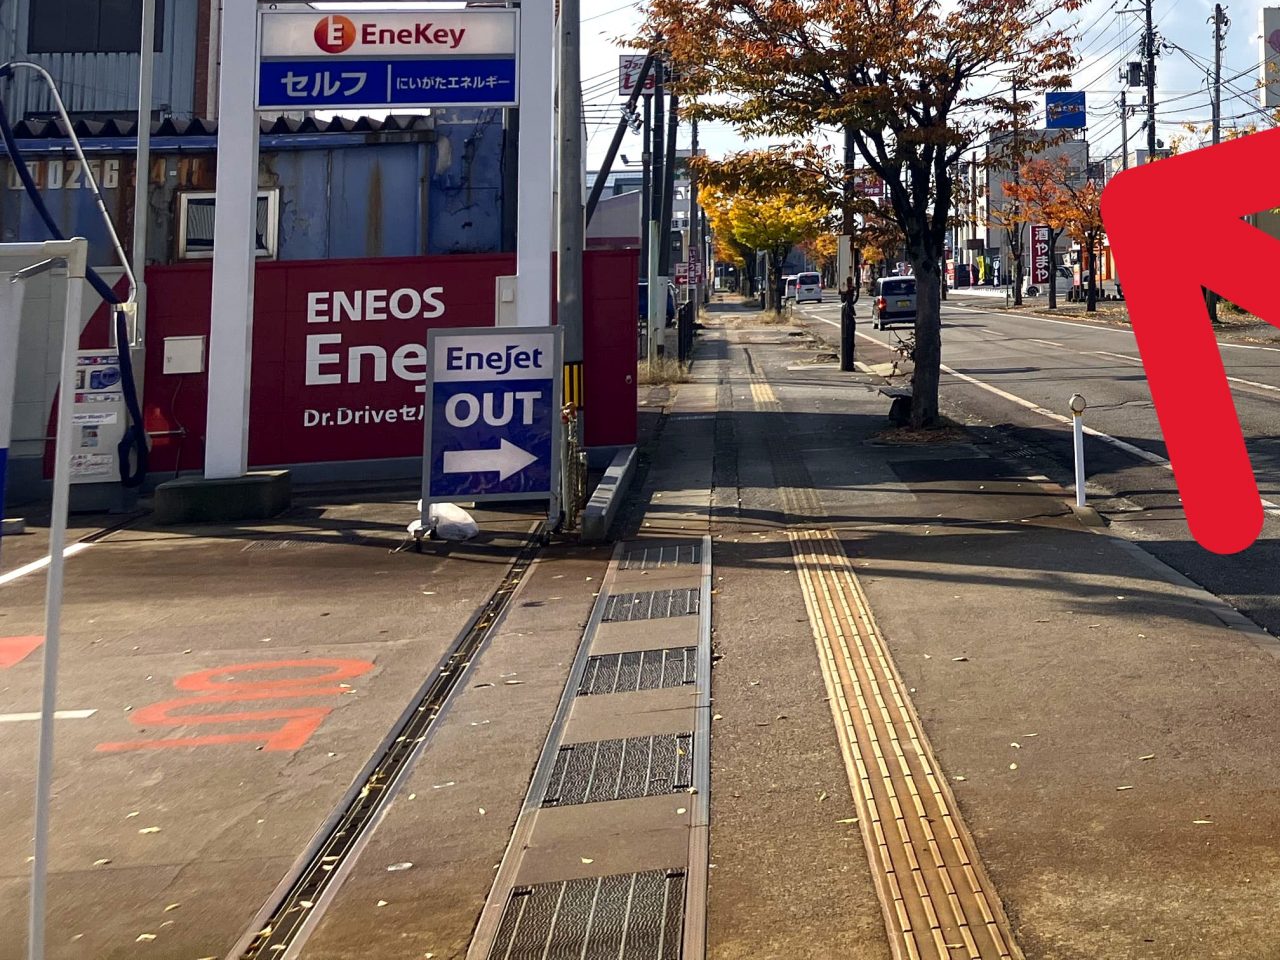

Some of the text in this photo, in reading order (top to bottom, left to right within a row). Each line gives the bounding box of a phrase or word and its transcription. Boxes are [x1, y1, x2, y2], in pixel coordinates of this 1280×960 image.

[361, 23, 466, 49] EneKey
[280, 71, 510, 98] セルフ にいがたエネルギー
[306, 286, 446, 324] ENEOS
[305, 332, 428, 393] Ene
[444, 390, 542, 428] OUT
